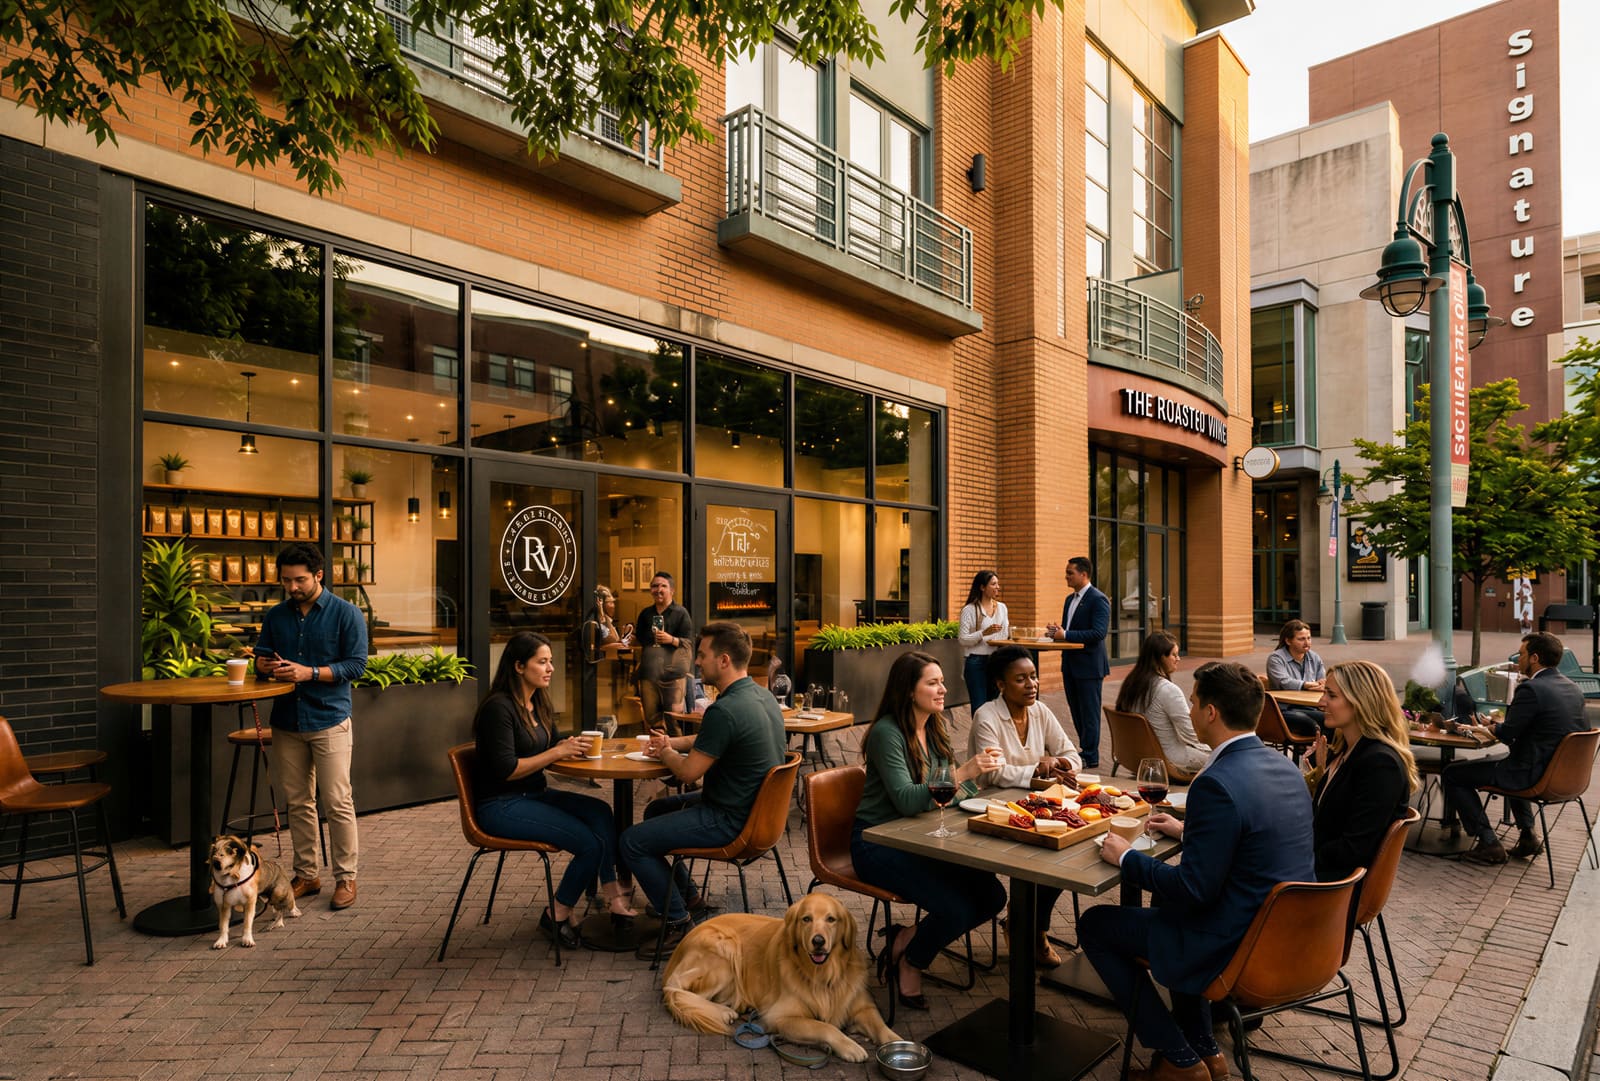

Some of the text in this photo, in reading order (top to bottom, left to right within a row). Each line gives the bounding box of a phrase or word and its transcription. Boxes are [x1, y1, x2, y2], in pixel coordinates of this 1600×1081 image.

[1125, 388, 1153, 418] THE
[1157, 395, 1206, 433] ROASTED
[521, 535, 561, 580] RV
